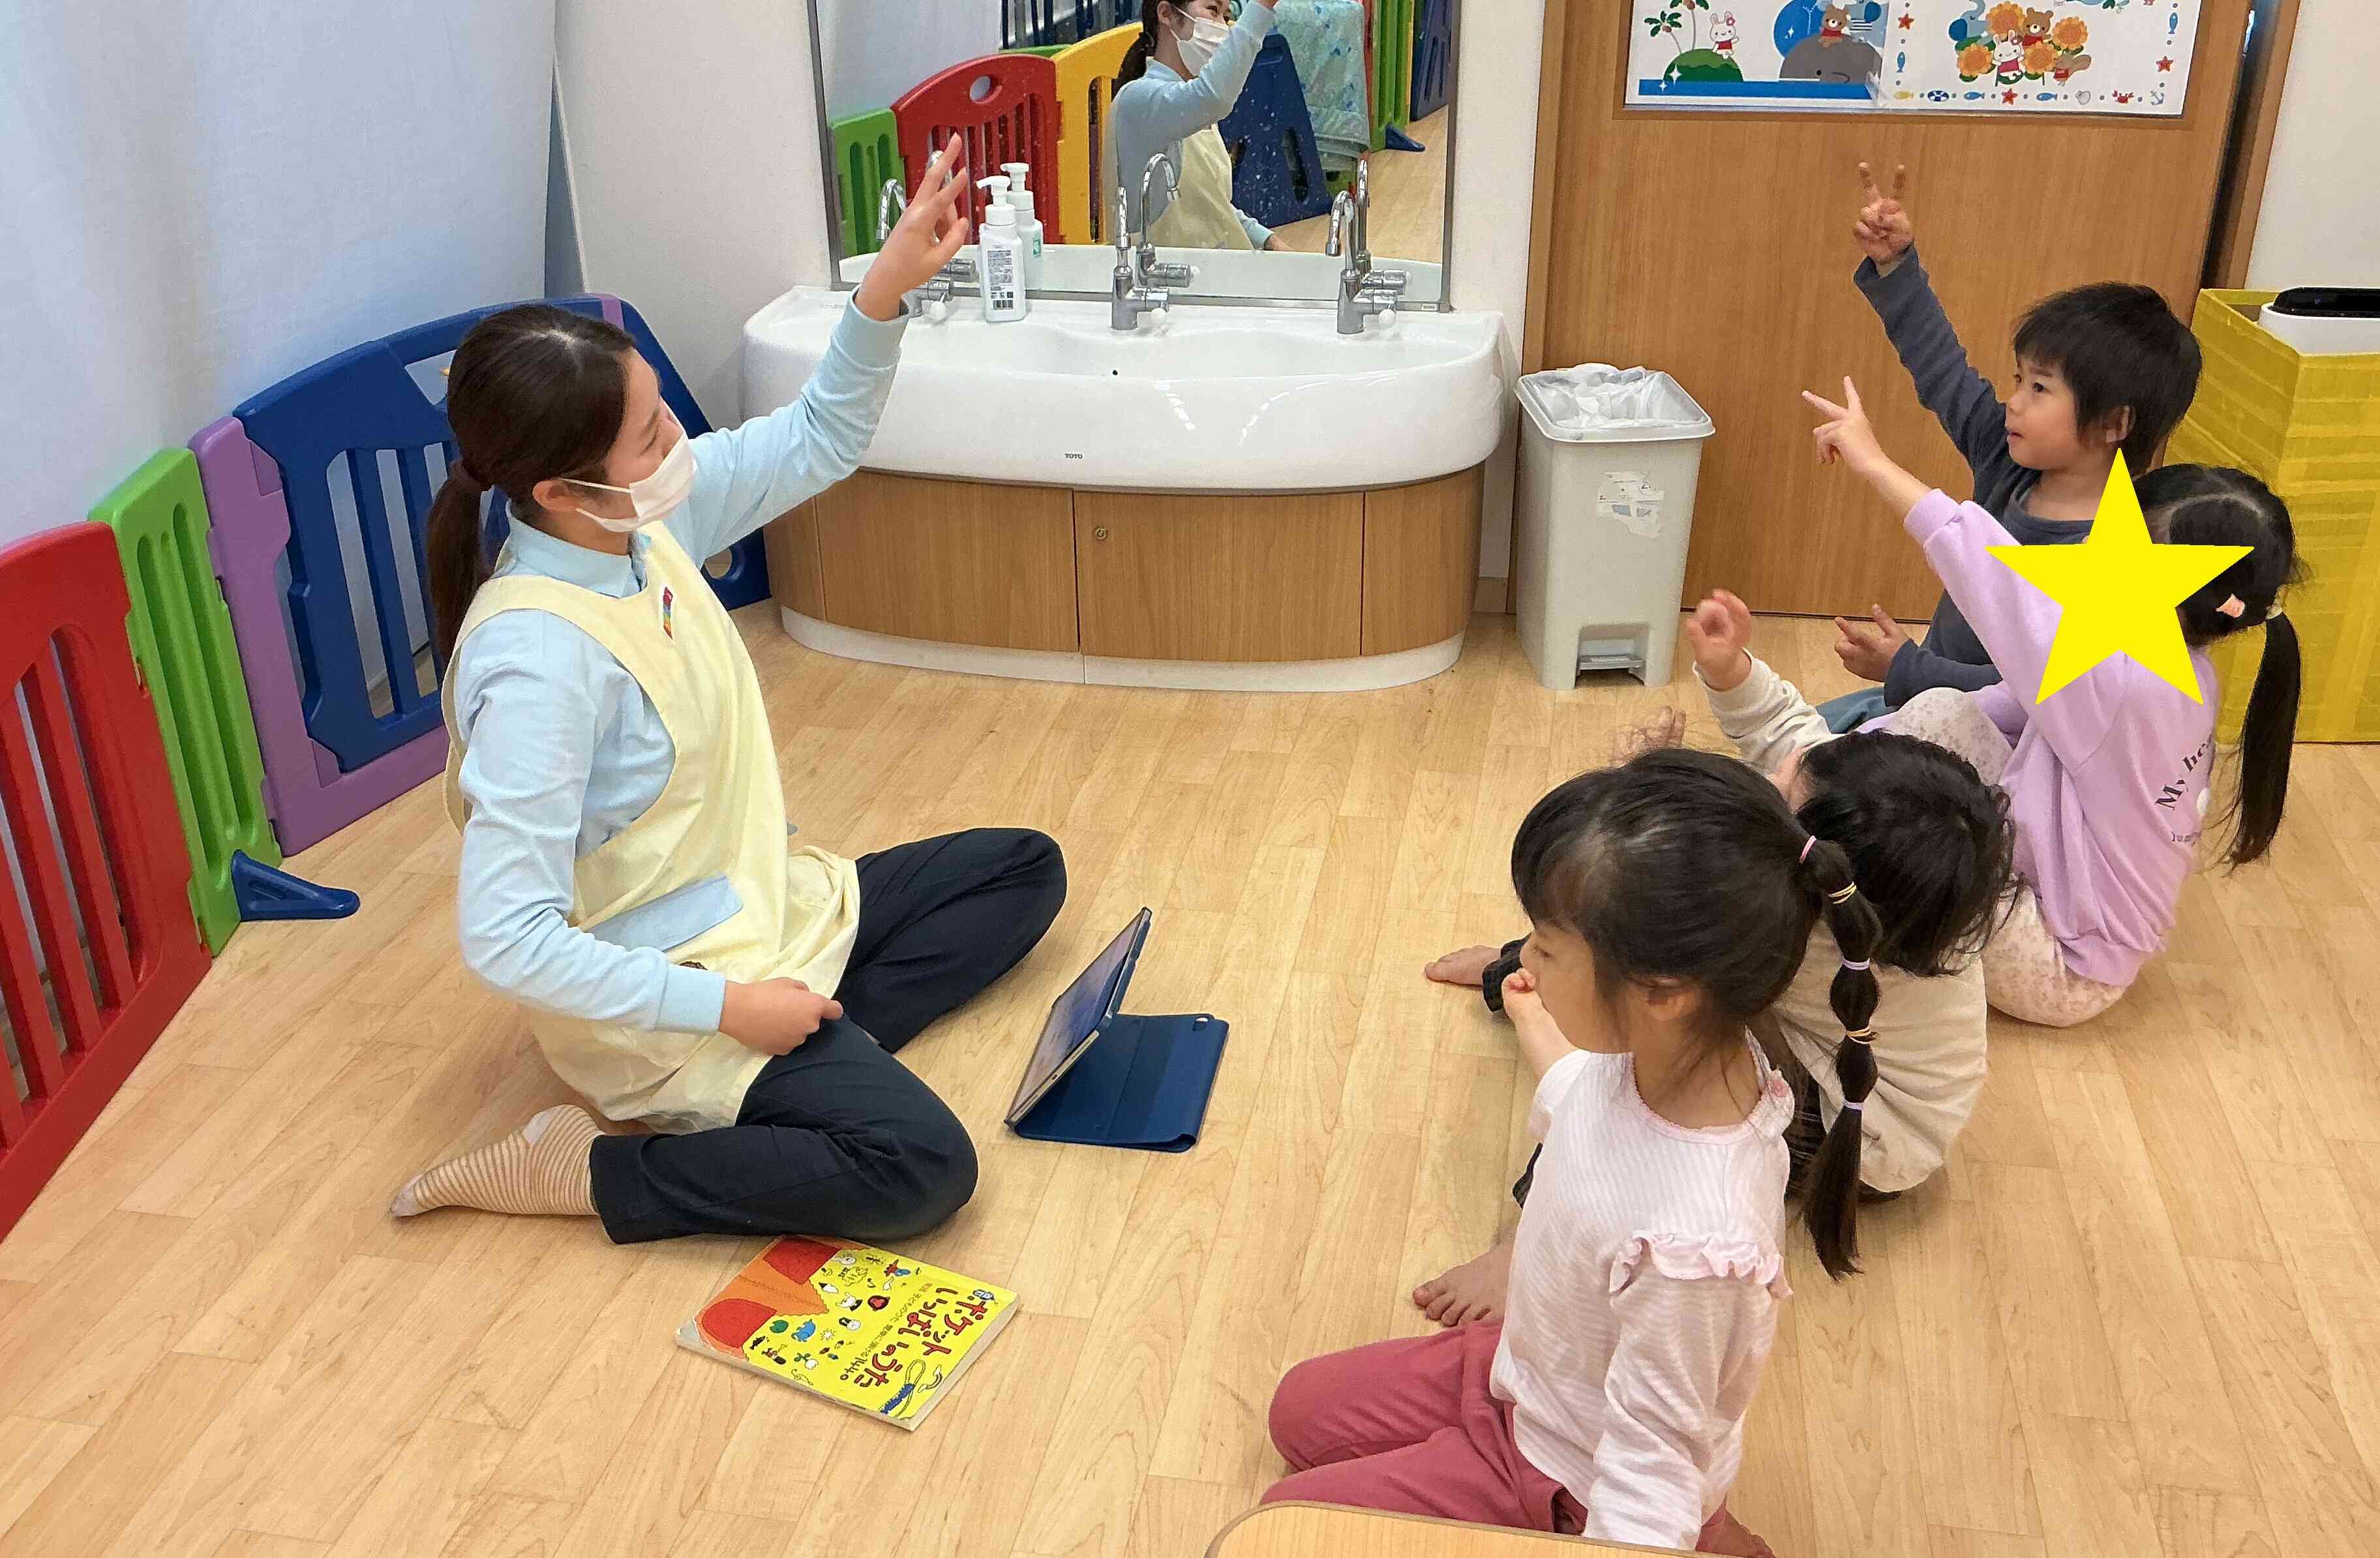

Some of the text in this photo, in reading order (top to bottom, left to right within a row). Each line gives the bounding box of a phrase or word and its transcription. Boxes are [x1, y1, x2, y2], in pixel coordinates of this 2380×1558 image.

[2155, 779, 2189, 811] My
[853, 1287, 959, 1388] いっぱいのうた
[921, 1296, 988, 1356] ポケット
